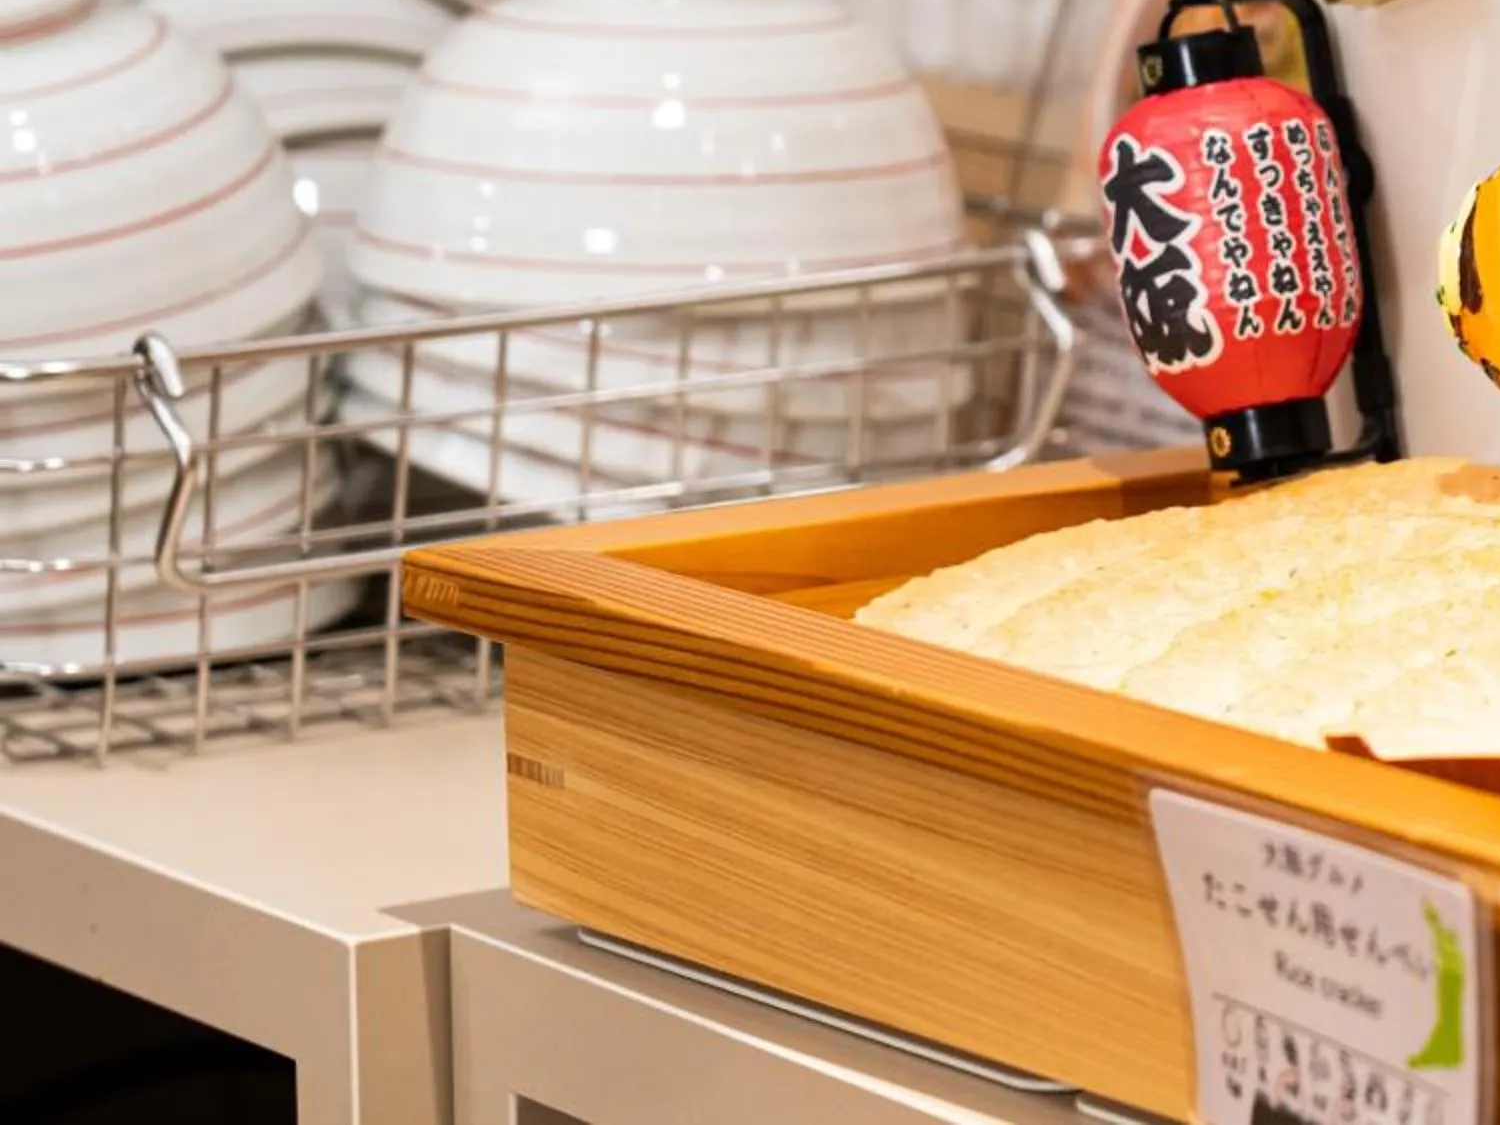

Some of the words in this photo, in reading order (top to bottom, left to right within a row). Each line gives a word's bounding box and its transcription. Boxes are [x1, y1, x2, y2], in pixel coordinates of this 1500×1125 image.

[1103, 138, 1214, 366] 大阪
[1204, 133, 1262, 337] なんでやねん
